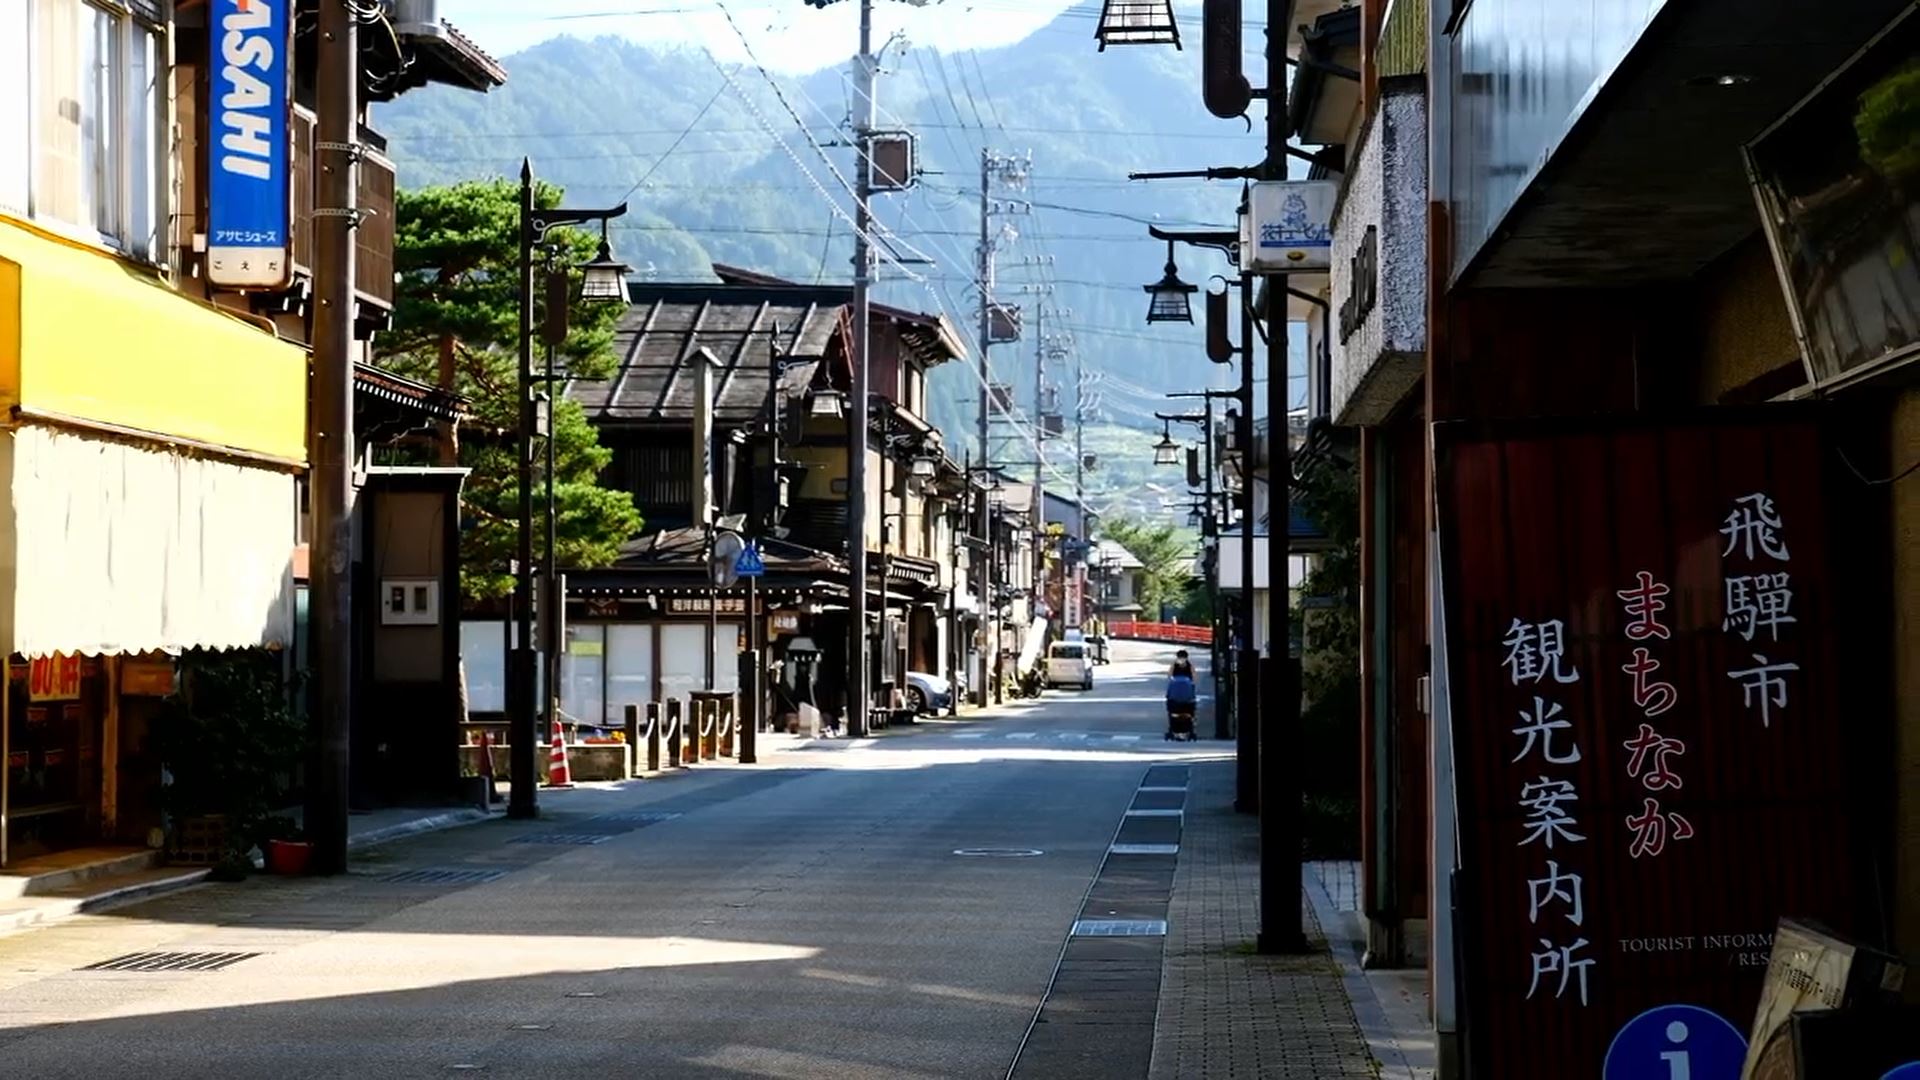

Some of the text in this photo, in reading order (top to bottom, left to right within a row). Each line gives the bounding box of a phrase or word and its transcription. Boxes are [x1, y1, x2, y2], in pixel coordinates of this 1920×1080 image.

[216, 230, 276, 243] アサヒシューズ
[213, 260, 278, 272] こえだ
[1617, 571, 1694, 858] まちなか
[1501, 617, 1596, 1007] 観光案内所
[1619, 936, 1695, 953] TOURIST
